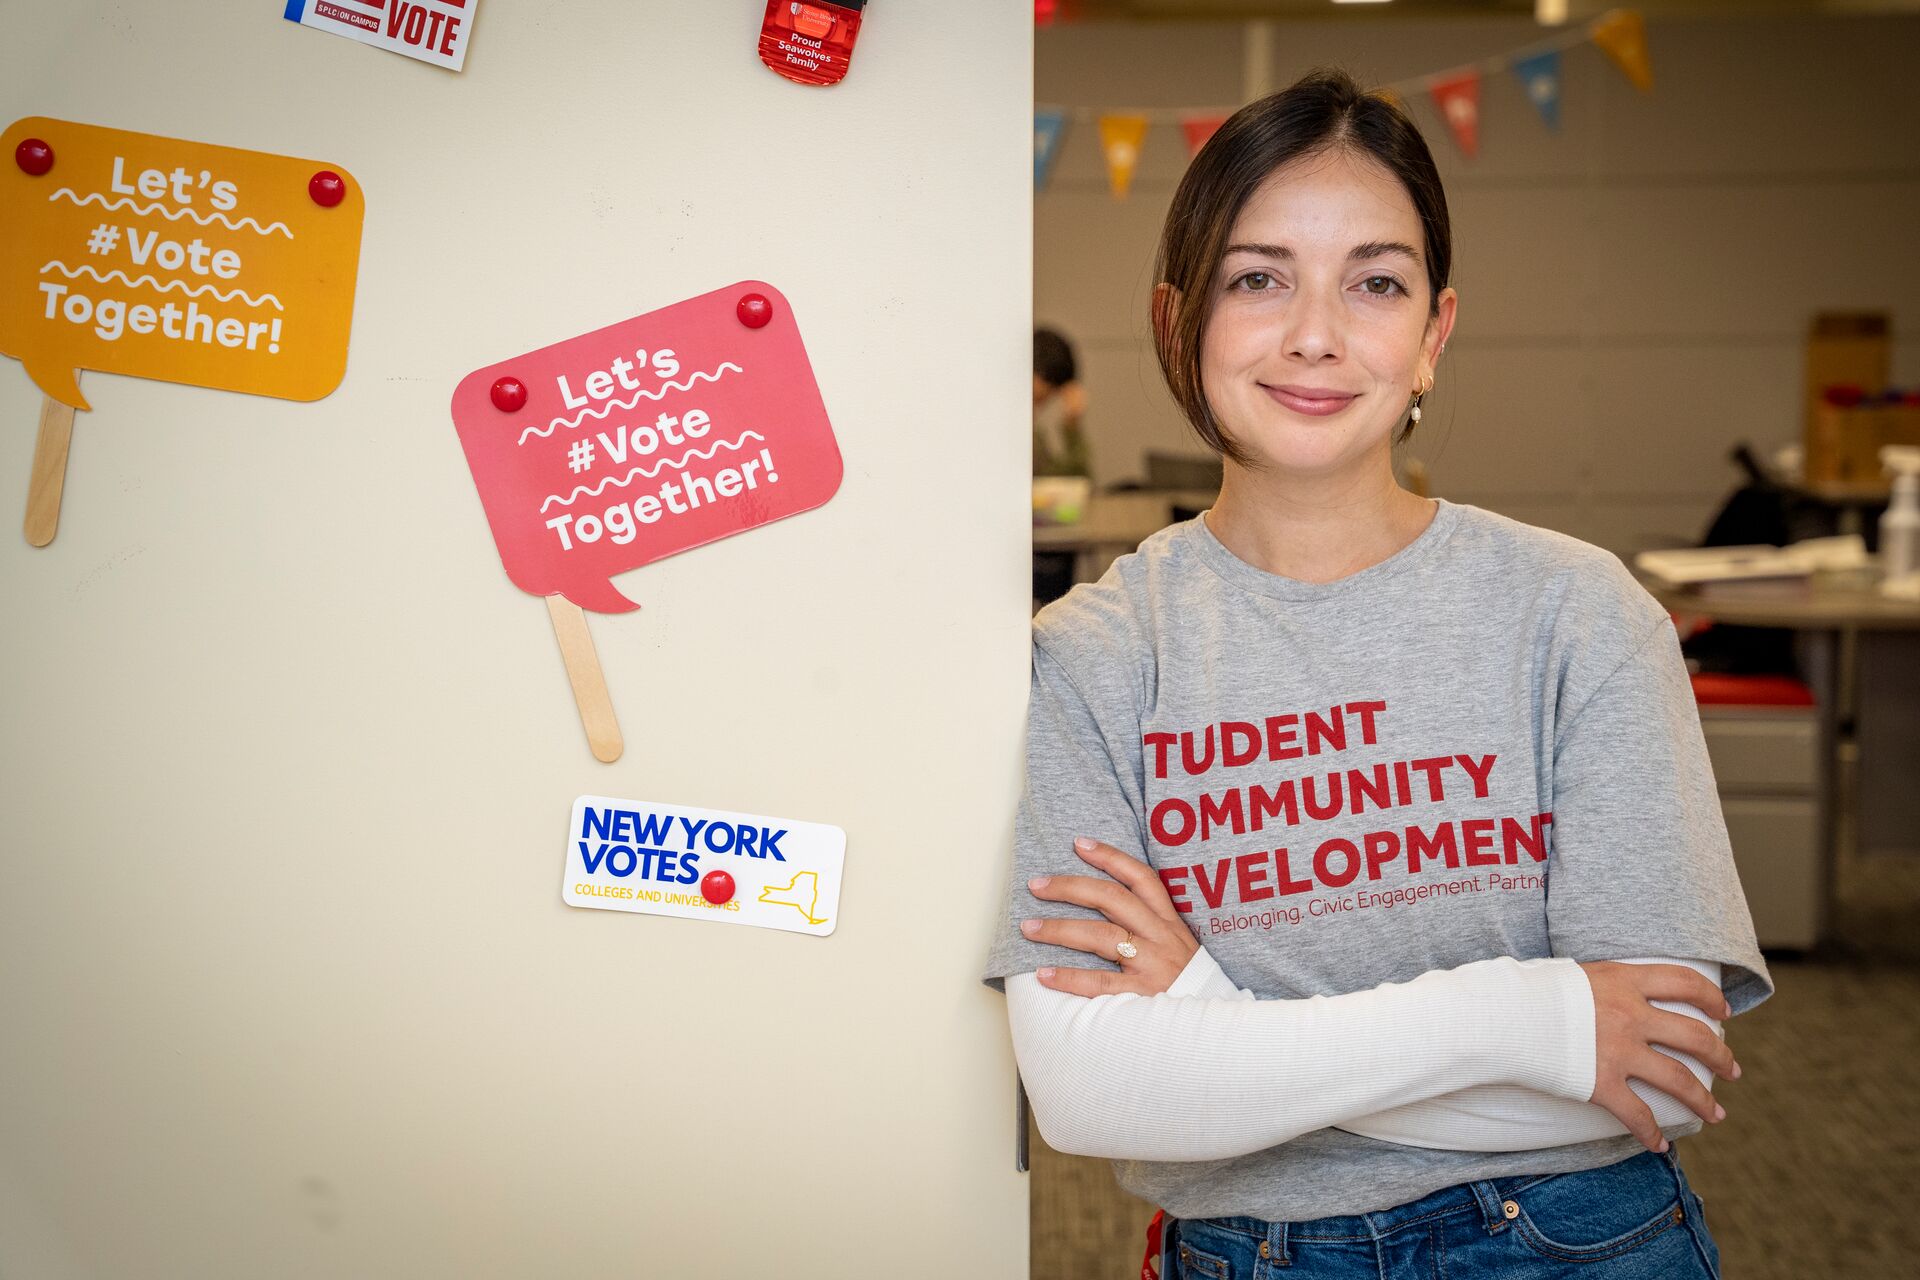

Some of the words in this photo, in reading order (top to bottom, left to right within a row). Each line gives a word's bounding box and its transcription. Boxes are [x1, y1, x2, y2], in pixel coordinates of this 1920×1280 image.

[317, 4, 338, 17] SPLC
[339, 11, 350, 21] ON
[350, 14, 378, 30] CAMPUS
[386, 0, 461, 57] VOTE
[791, 33, 822, 49] Proud
[778, 40, 831, 63] Seawolves
[786, 53, 819, 72] Family
[87, 223, 242, 279] #Vote
[39, 282, 283, 354] Together!
[567, 408, 711, 474] #Vote
[545, 448, 779, 551] Together!
[1143, 700, 1387, 779] TUDENT
[1149, 754, 1497, 847] OMMUNITY
[582, 806, 675, 847] NEW
[678, 816, 788, 862] YORK
[578, 841, 700, 885] VOTES
[1157, 812, 1553, 914] EVELOPMEN
[575, 883, 634, 900] COLLEGES
[636, 890, 662, 902] AND
[1210, 906, 1305, 935] Belonging.
[1308, 897, 1354, 917] Civic
[1358, 878, 1486, 909] Engagement.
